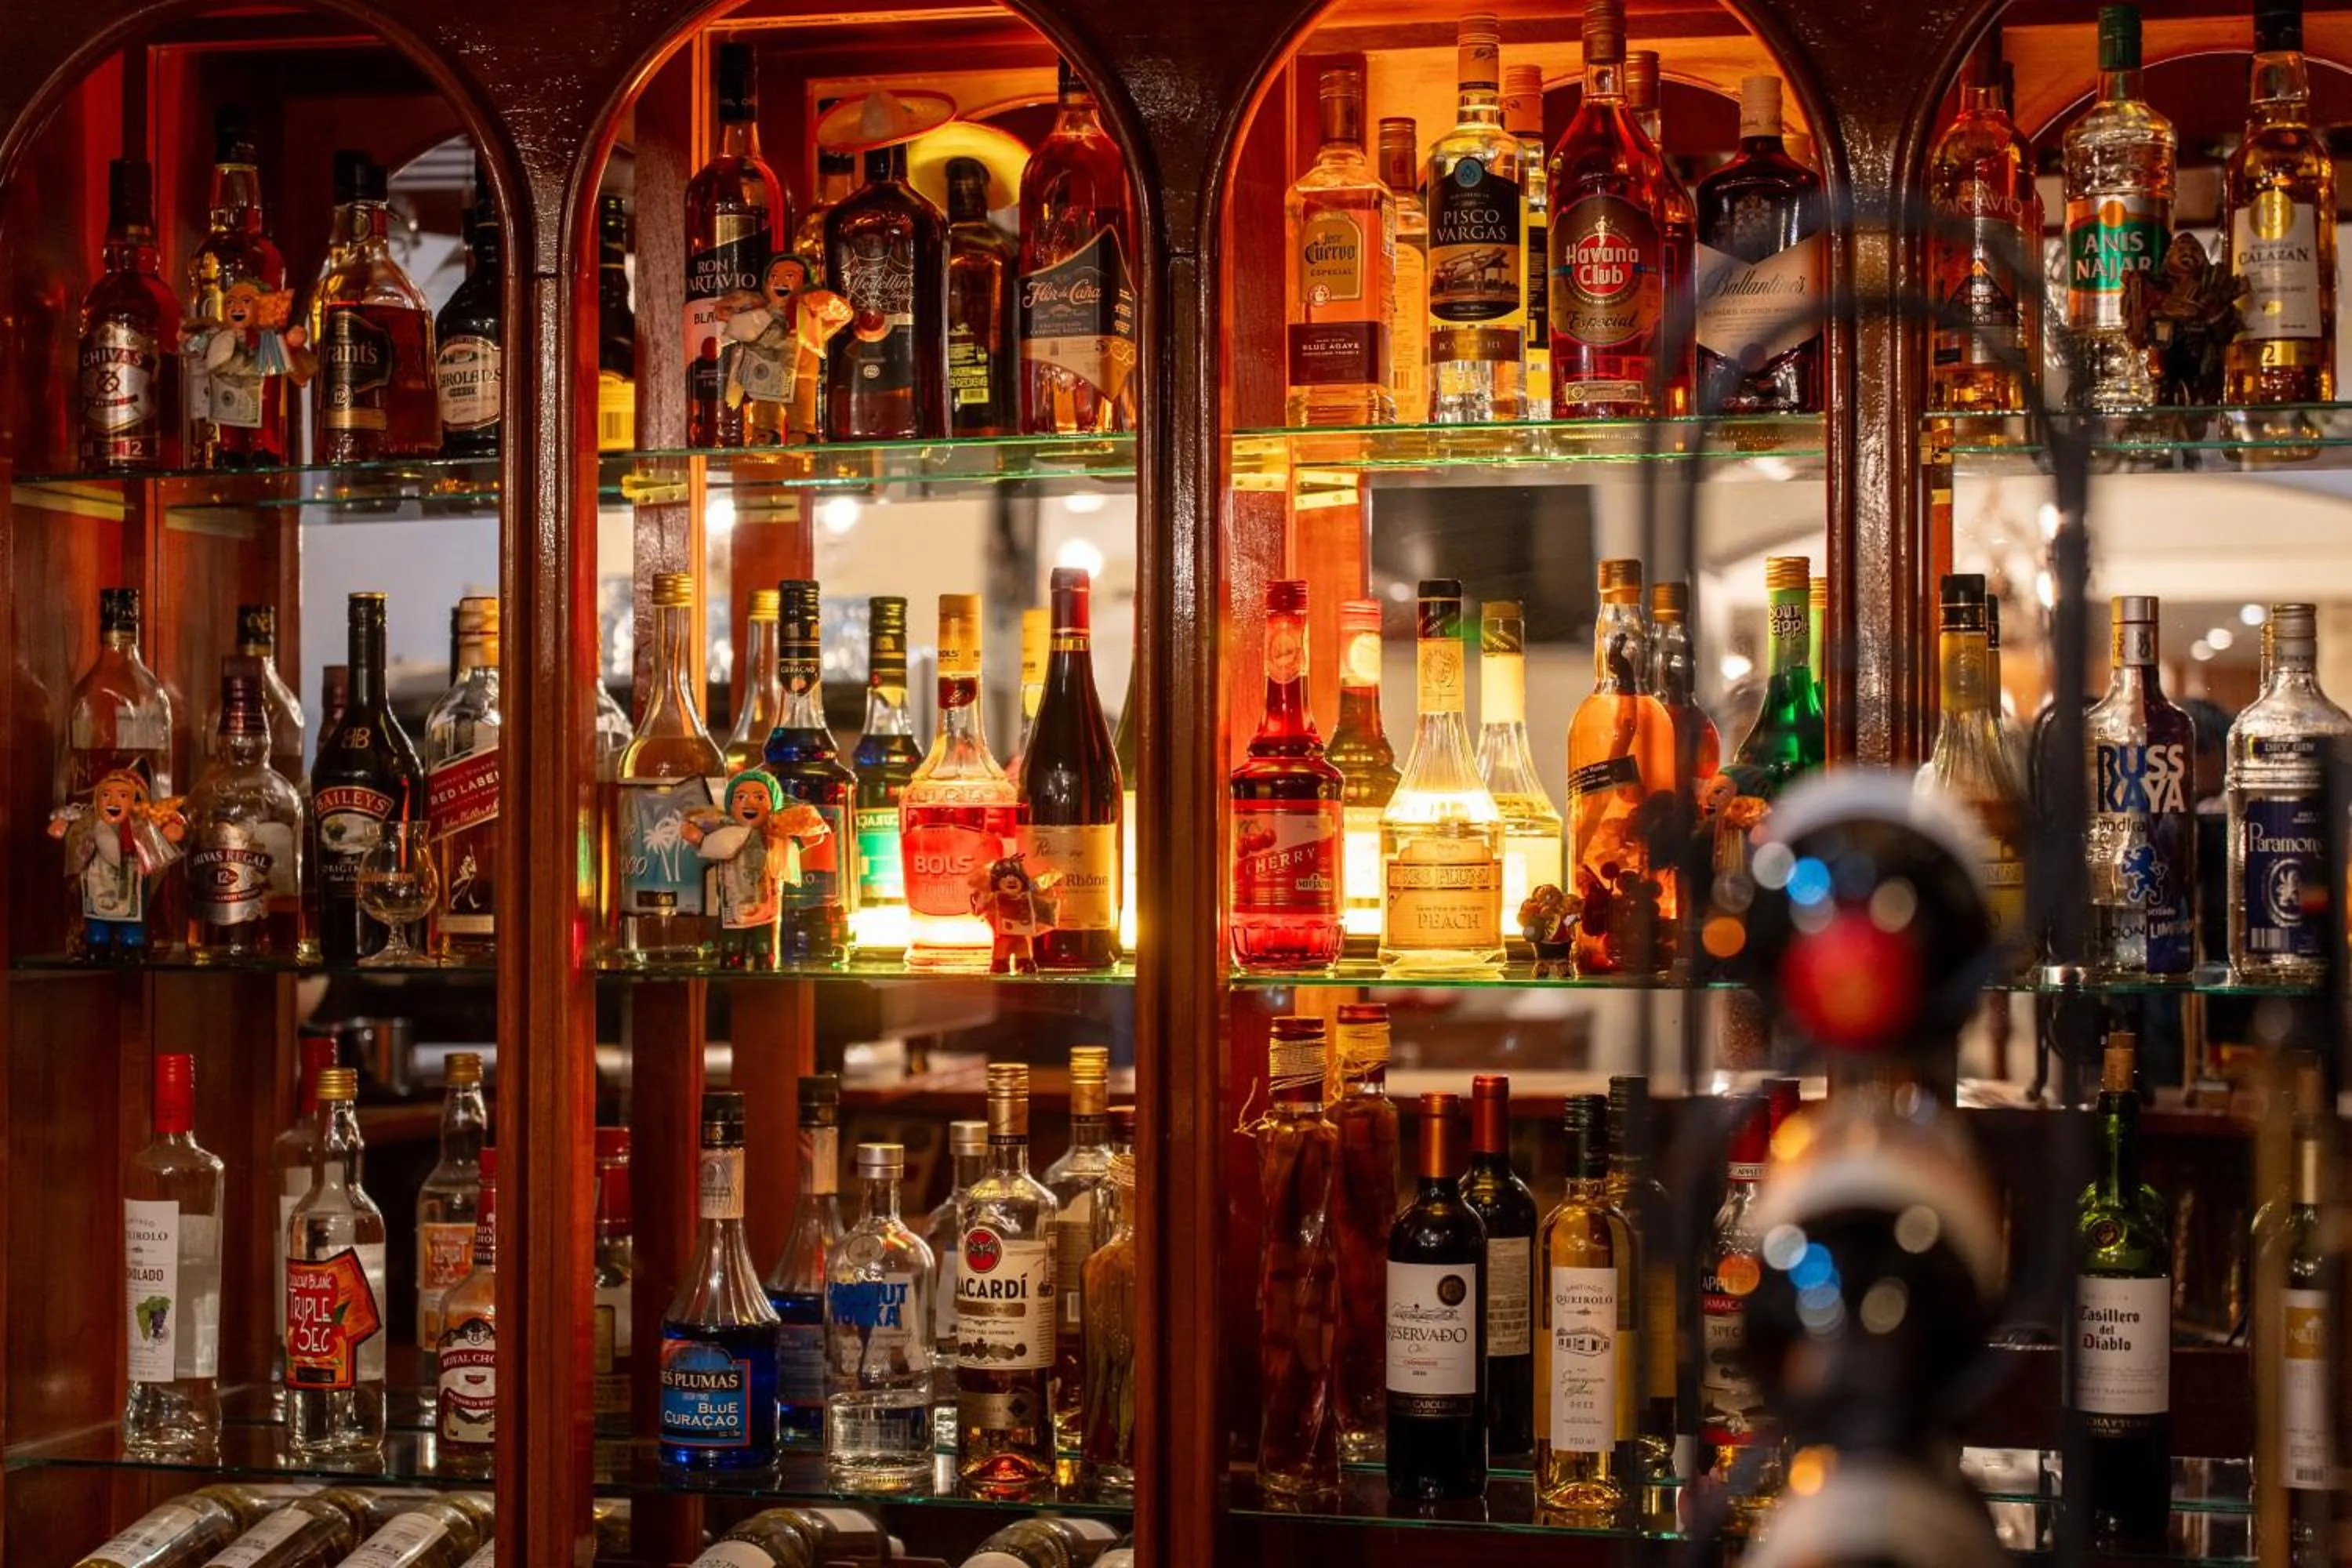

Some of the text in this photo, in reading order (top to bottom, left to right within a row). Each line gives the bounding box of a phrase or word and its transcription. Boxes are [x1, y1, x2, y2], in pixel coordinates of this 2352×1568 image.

[1443, 209, 1501, 225] PISCO
[1437, 227, 1508, 242] VARGAS
[2085, 232, 2144, 254] ANIS
[1305, 241, 1356, 264] Cuervo
[1566, 245, 1639, 266] Havana
[2238, 247, 2310, 265] CALAZAN
[697, 260, 728, 274] RON
[1579, 264, 1624, 286] Club
[688, 273, 757, 292] ARTAVIO
[1022, 281, 1058, 308] Flor
[1069, 278, 1102, 305] Caña
[694, 311, 716, 325] BLA
[1566, 310, 1637, 332] Especial
[82, 349, 143, 367] CHIVAS
[323, 341, 379, 364] rant's
[1772, 614, 1809, 639] appl
[2096, 744, 2185, 779] RUSS
[315, 788, 390, 814] BAILEYS
[430, 789, 456, 806] RED
[192, 851, 267, 869] HIVAS REGAL
[913, 854, 976, 875] BOLS
[1417, 913, 1481, 929] PEACH
[125, 1229, 169, 1241] EIROLO
[956, 1272, 1028, 1300] ACARDÍ
[288, 1287, 332, 1323] TRIPLE
[1555, 1294, 1613, 1305] QUEIROLO
[2078, 1305, 2140, 1324] Casillero
[297, 1316, 331, 1352] SEC
[2099, 1325, 2115, 1335] del
[2082, 1333, 2132, 1352] Diablo
[673, 1372, 739, 1389] PLUMAS
[697, 1402, 738, 1414] BLUE
[664, 1411, 739, 1430] CURAÇAO
